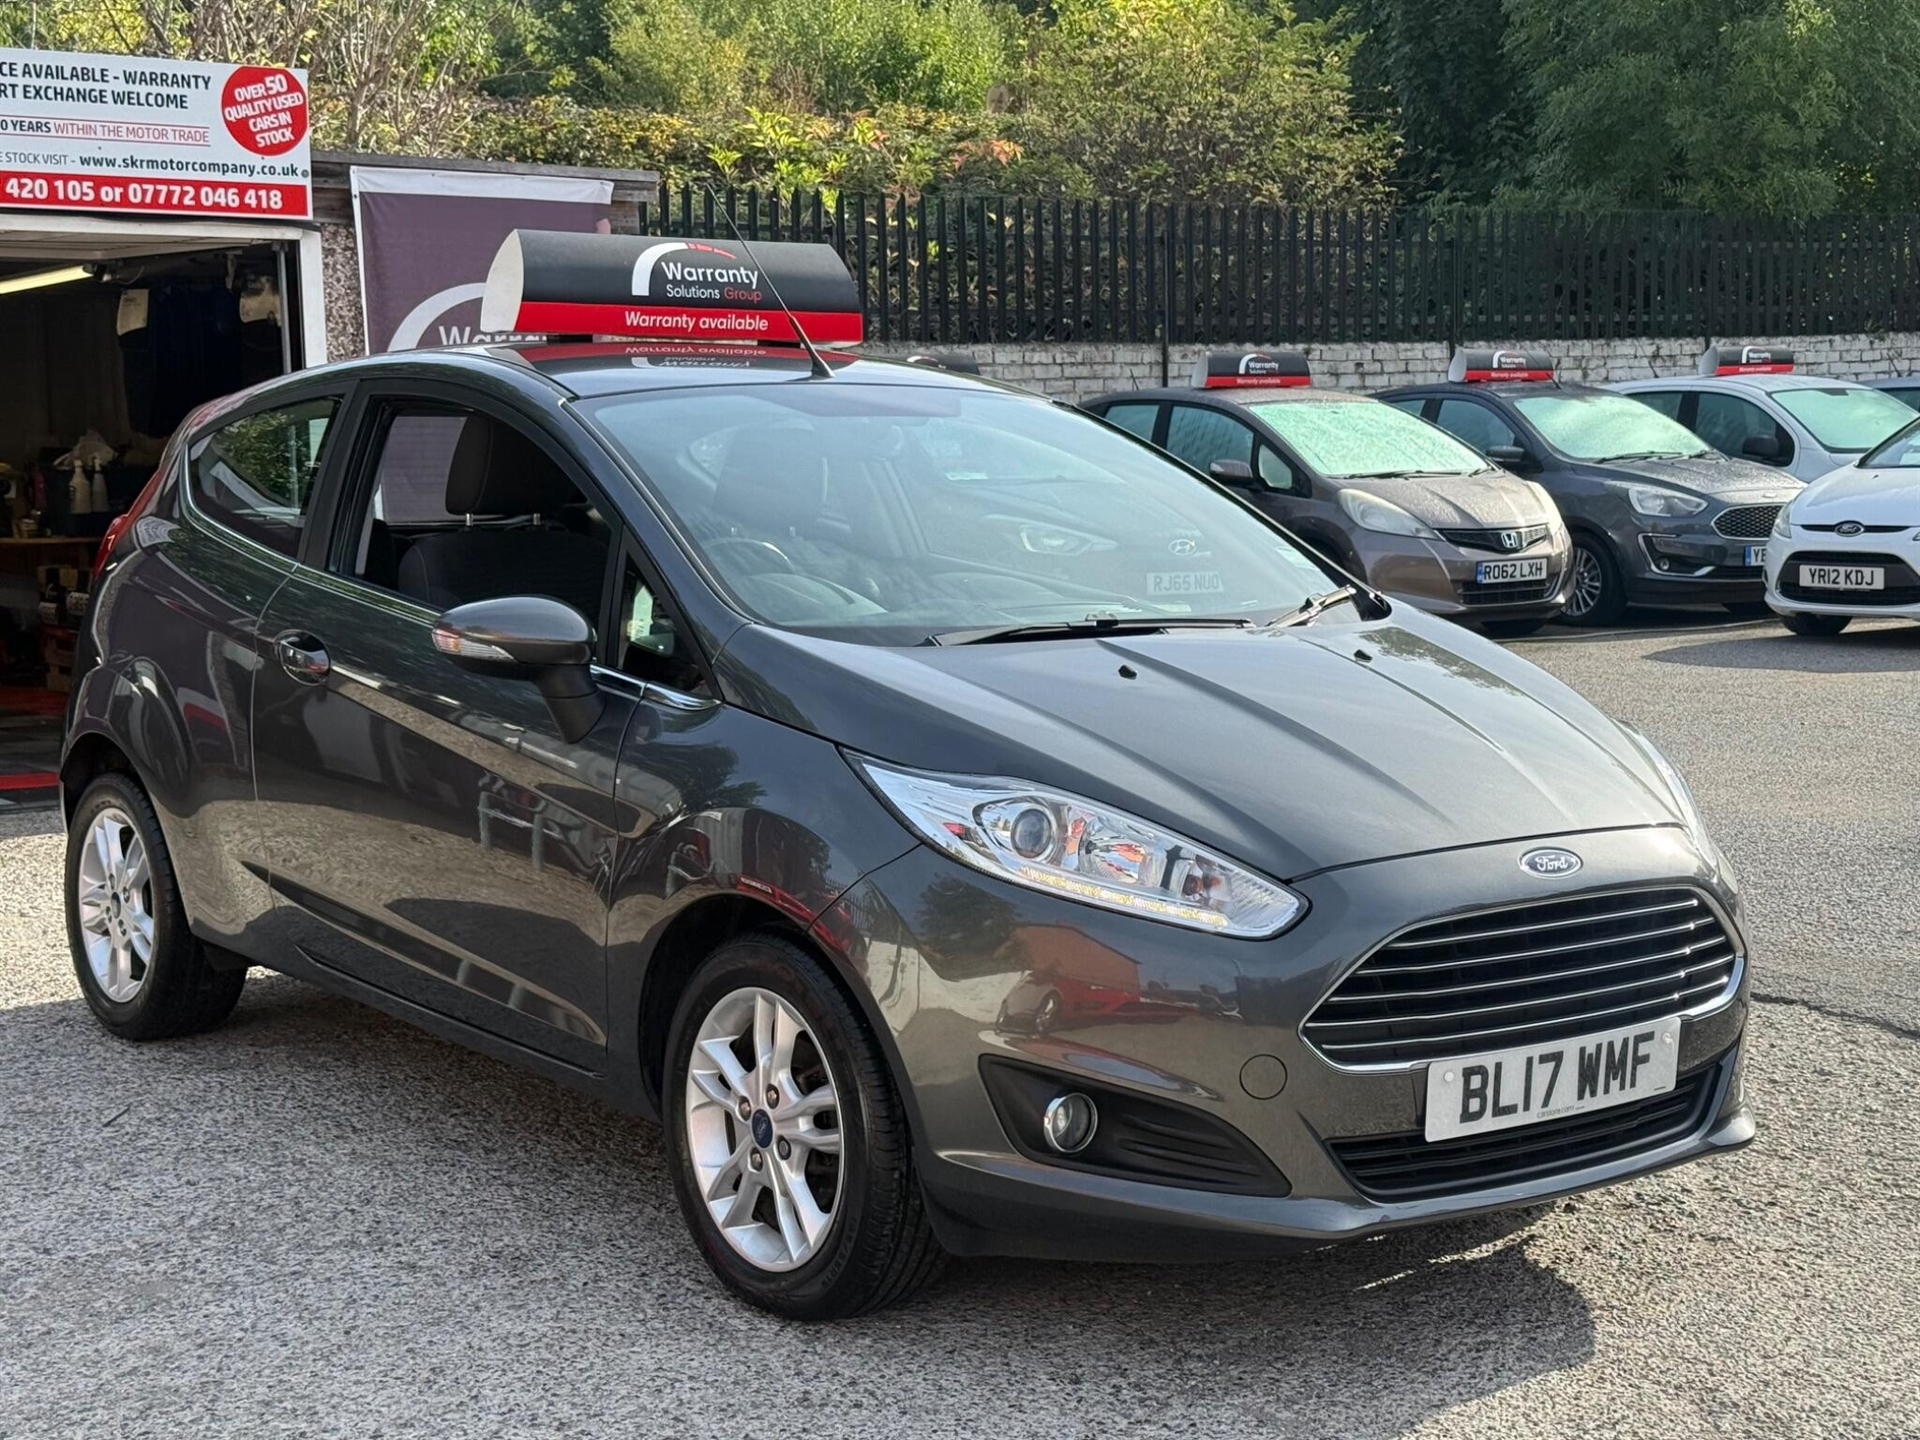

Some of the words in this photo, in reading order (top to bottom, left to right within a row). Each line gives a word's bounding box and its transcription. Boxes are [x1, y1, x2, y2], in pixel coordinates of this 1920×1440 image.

[22, 62, 110, 83] AVAILABLE
[123, 69, 211, 90] WARRANTY
[234, 83, 267, 101] OVER
[264, 74, 288, 95] 50
[23, 84, 108, 104] EXCHANGE
[111, 90, 188, 109] WELCOME
[224, 98, 273, 122] QUALITY
[272, 92, 304, 110] USED
[11, 120, 51, 133] YEARS
[54, 122, 97, 136] WITHIN
[100, 124, 123, 137] THE
[126, 126, 169, 140] MOTOR
[171, 128, 210, 143] TRADE
[249, 114, 279, 132] CARS
[278, 111, 293, 125] IN
[255, 127, 295, 147] STOCK
[5, 152, 42, 164] STOCK
[42, 153, 69, 165] VISIT
[79, 154, 299, 177] www.skrmotorcompany.co.uk
[5, 177, 49, 199] 420
[54, 179, 95, 201] 105
[100, 185, 124, 202] or
[128, 182, 196, 206] 07772
[200, 186, 240, 208] 046
[244, 189, 283, 210] 418
[661, 261, 758, 290] Warranty
[666, 283, 720, 299] Solutions
[723, 286, 762, 304] Group
[624, 310, 697, 332] Warranty
[699, 313, 769, 332] available
[1248, 360, 1279, 371] Warranty
[1484, 563, 1517, 580] RO62
[1520, 561, 1543, 578] LXH
[1809, 568, 1840, 585] YR12
[1844, 569, 1874, 586] KDJ
[1534, 854, 1568, 871] Ford
[1459, 1050, 1564, 1124] BL17
[1577, 1030, 1656, 1101] WMF
